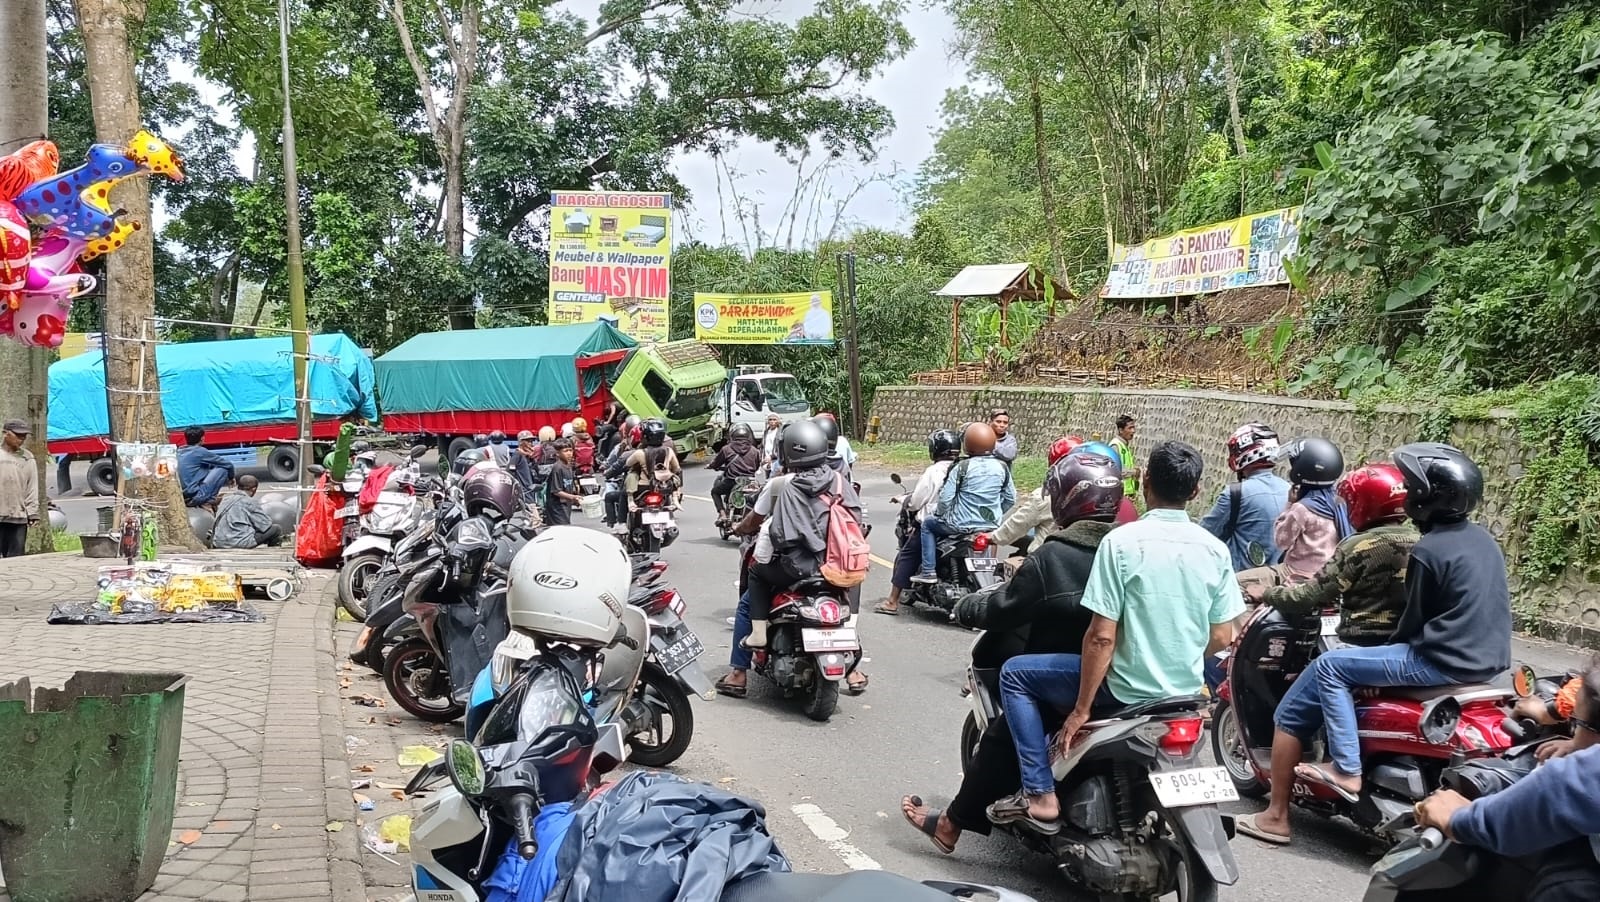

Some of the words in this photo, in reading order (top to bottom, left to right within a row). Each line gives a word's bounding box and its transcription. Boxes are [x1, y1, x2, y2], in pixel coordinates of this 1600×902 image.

[557, 195, 606, 206] HARGA
[608, 195, 664, 207] GROSIR
[1188, 229, 1231, 253] PANTAU
[554, 251, 594, 262] Meubel
[595, 252, 604, 262] &
[607, 253, 664, 266] Wallpaper
[1154, 257, 1197, 279] RELAWAN
[1200, 248, 1245, 272] GUMITIR
[551, 266, 584, 285] Bang
[585, 266, 667, 298] HASYIM
[556, 293, 603, 302] GENTENG
[700, 308, 715, 316] KPK
[720, 305, 750, 317] PARA
[751, 305, 796, 317] PEMUDIK
[728, 326, 788, 334] DIPERJALANAN
[539, 574, 571, 587] MAZ
[1154, 776, 1163, 789] P
[1170, 772, 1206, 788] 6094
[1203, 788, 1236, 799] 07-28
[427, 893, 455, 902] HONDA
